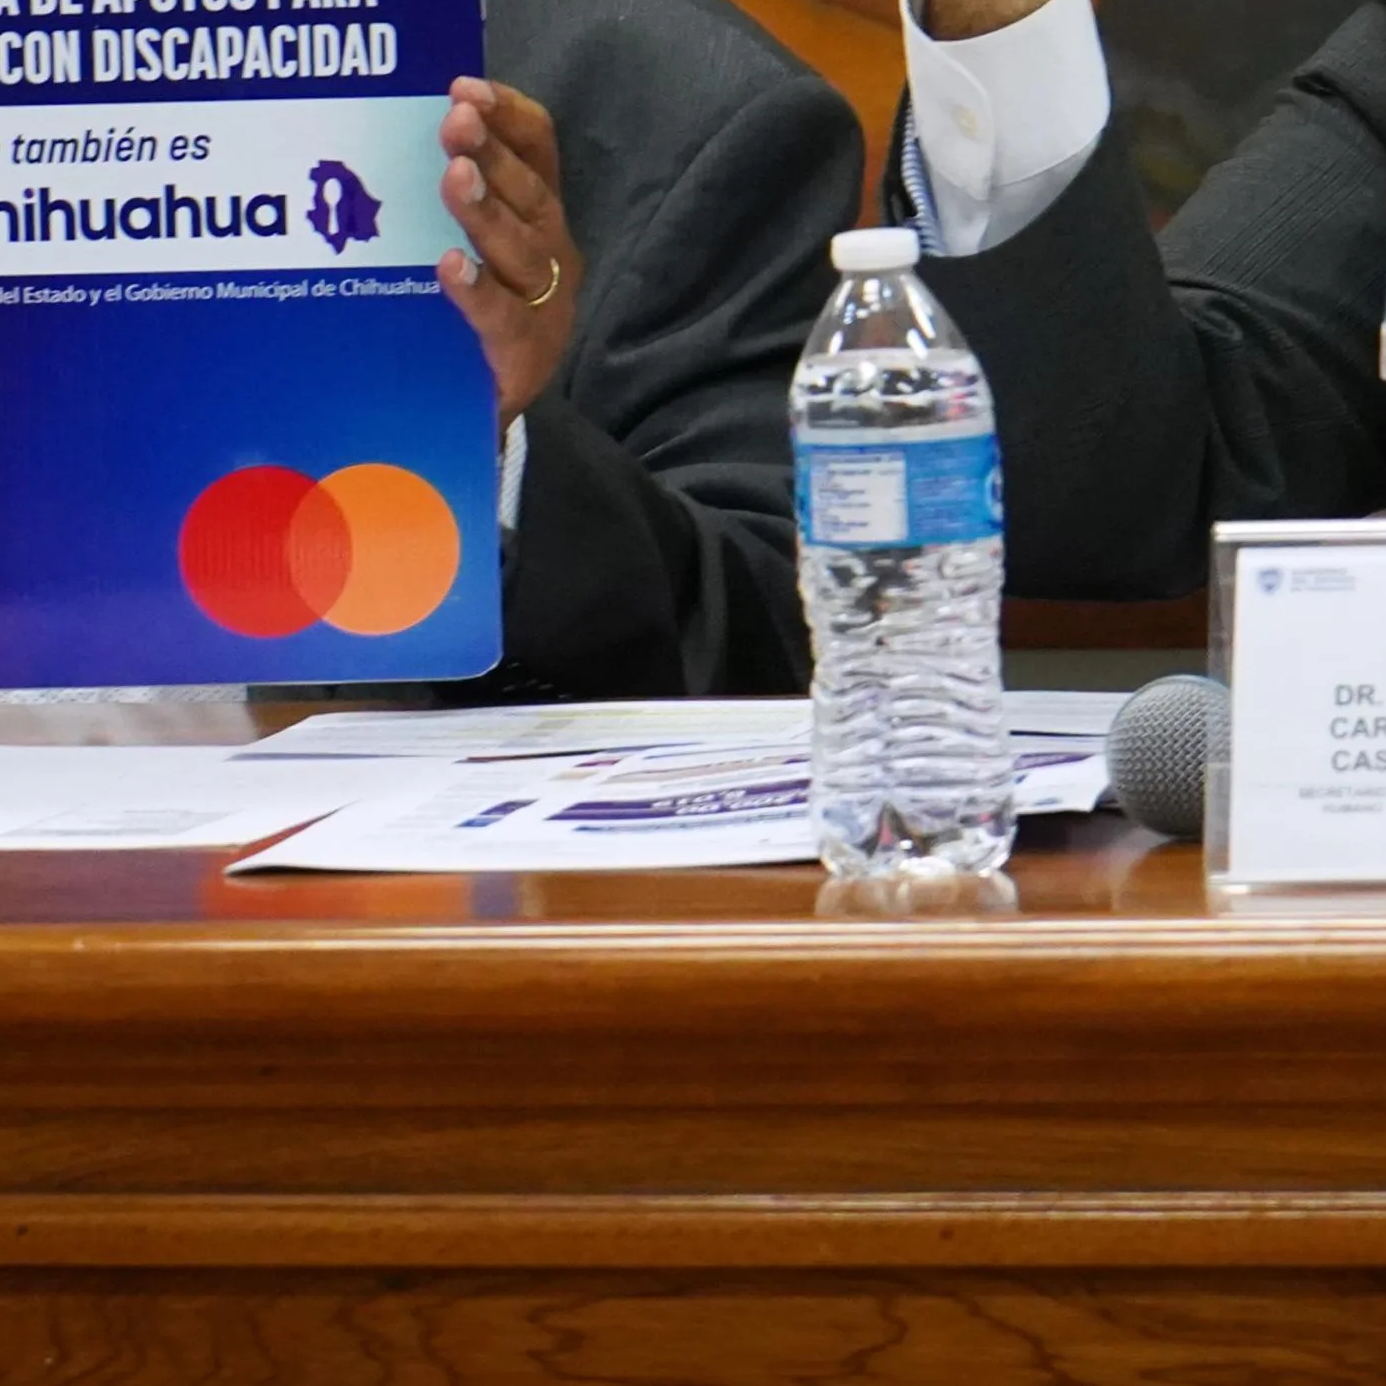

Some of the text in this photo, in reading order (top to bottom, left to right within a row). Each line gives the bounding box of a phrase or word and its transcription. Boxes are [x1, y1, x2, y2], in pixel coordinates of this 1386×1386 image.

[93, 23, 397, 83] DISCAPACIDAD
[10, 127, 158, 165] también
[169, 134, 211, 161] es
[23, 285, 86, 303] Estado
[89, 285, 103, 306] y
[104, 283, 122, 301] el
[125, 282, 213, 301] Gobierno
[217, 279, 308, 301] Municipal
[312, 278, 336, 296] de
[339, 277, 439, 295] Chihuahua
[1334, 683, 1383, 706] DR.
